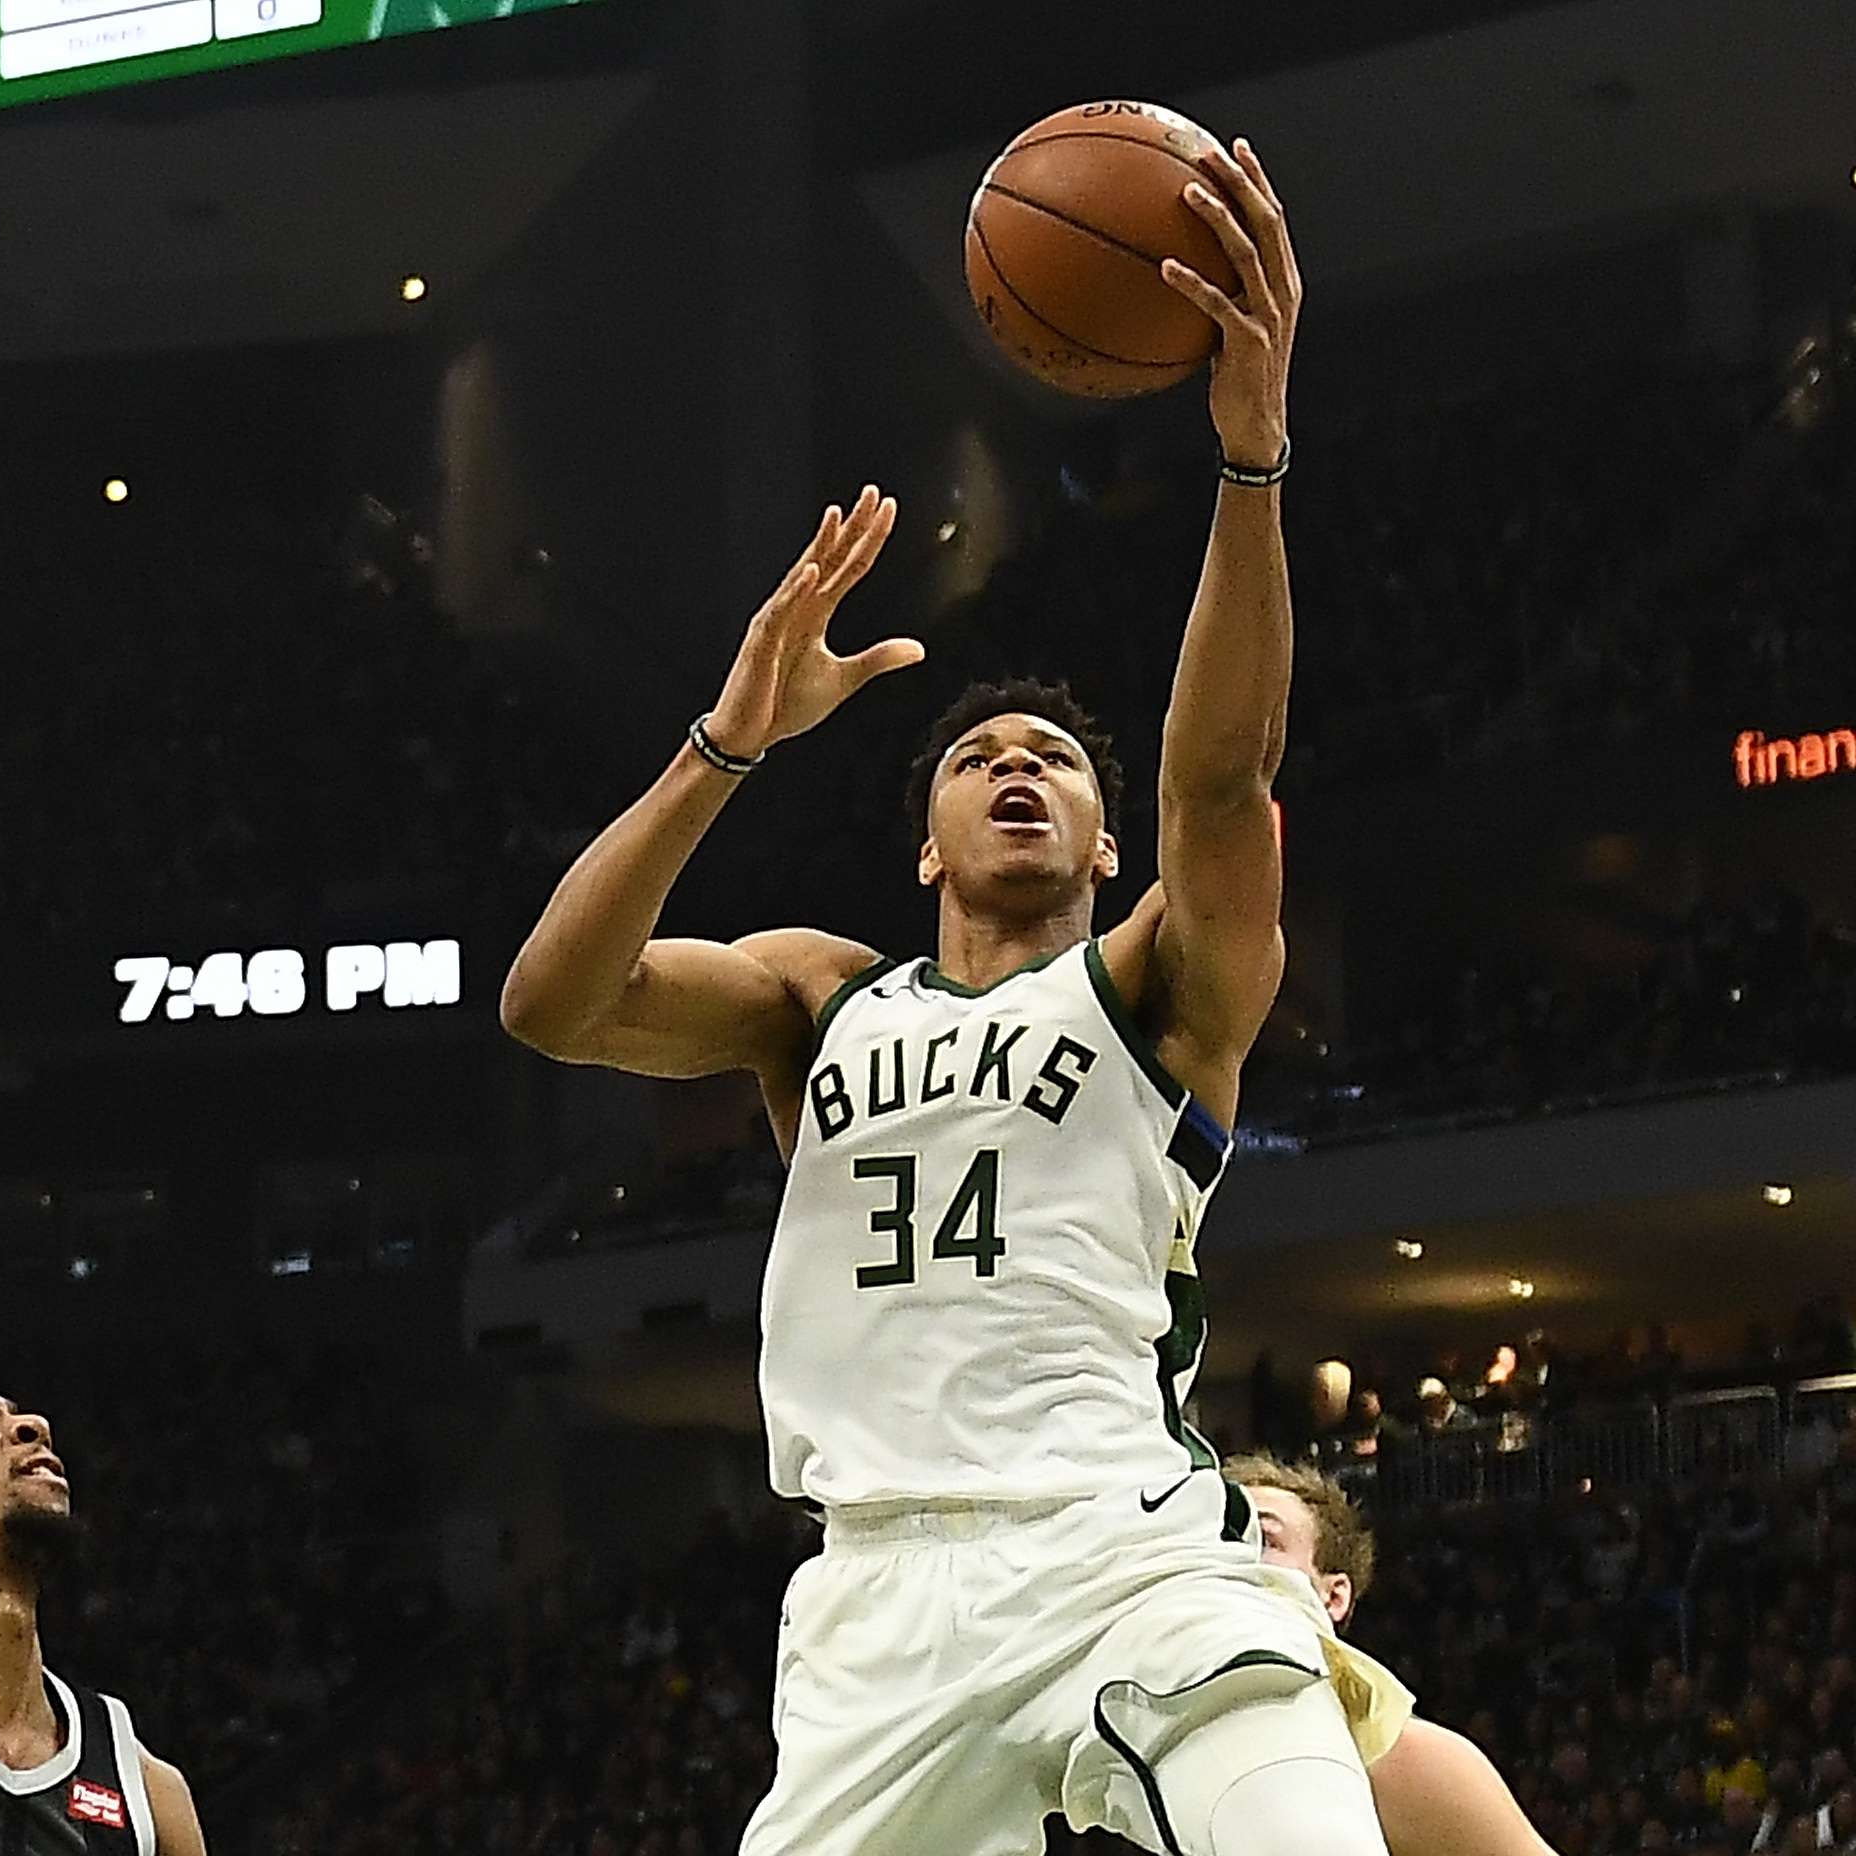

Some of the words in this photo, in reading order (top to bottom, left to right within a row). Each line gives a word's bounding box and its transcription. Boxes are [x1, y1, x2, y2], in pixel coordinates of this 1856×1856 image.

[113, 949, 307, 1024] 7:46
[326, 939, 461, 1012] PM
[809, 1020, 1099, 1143] BUCKS
[851, 1147, 1007, 1291] 34
